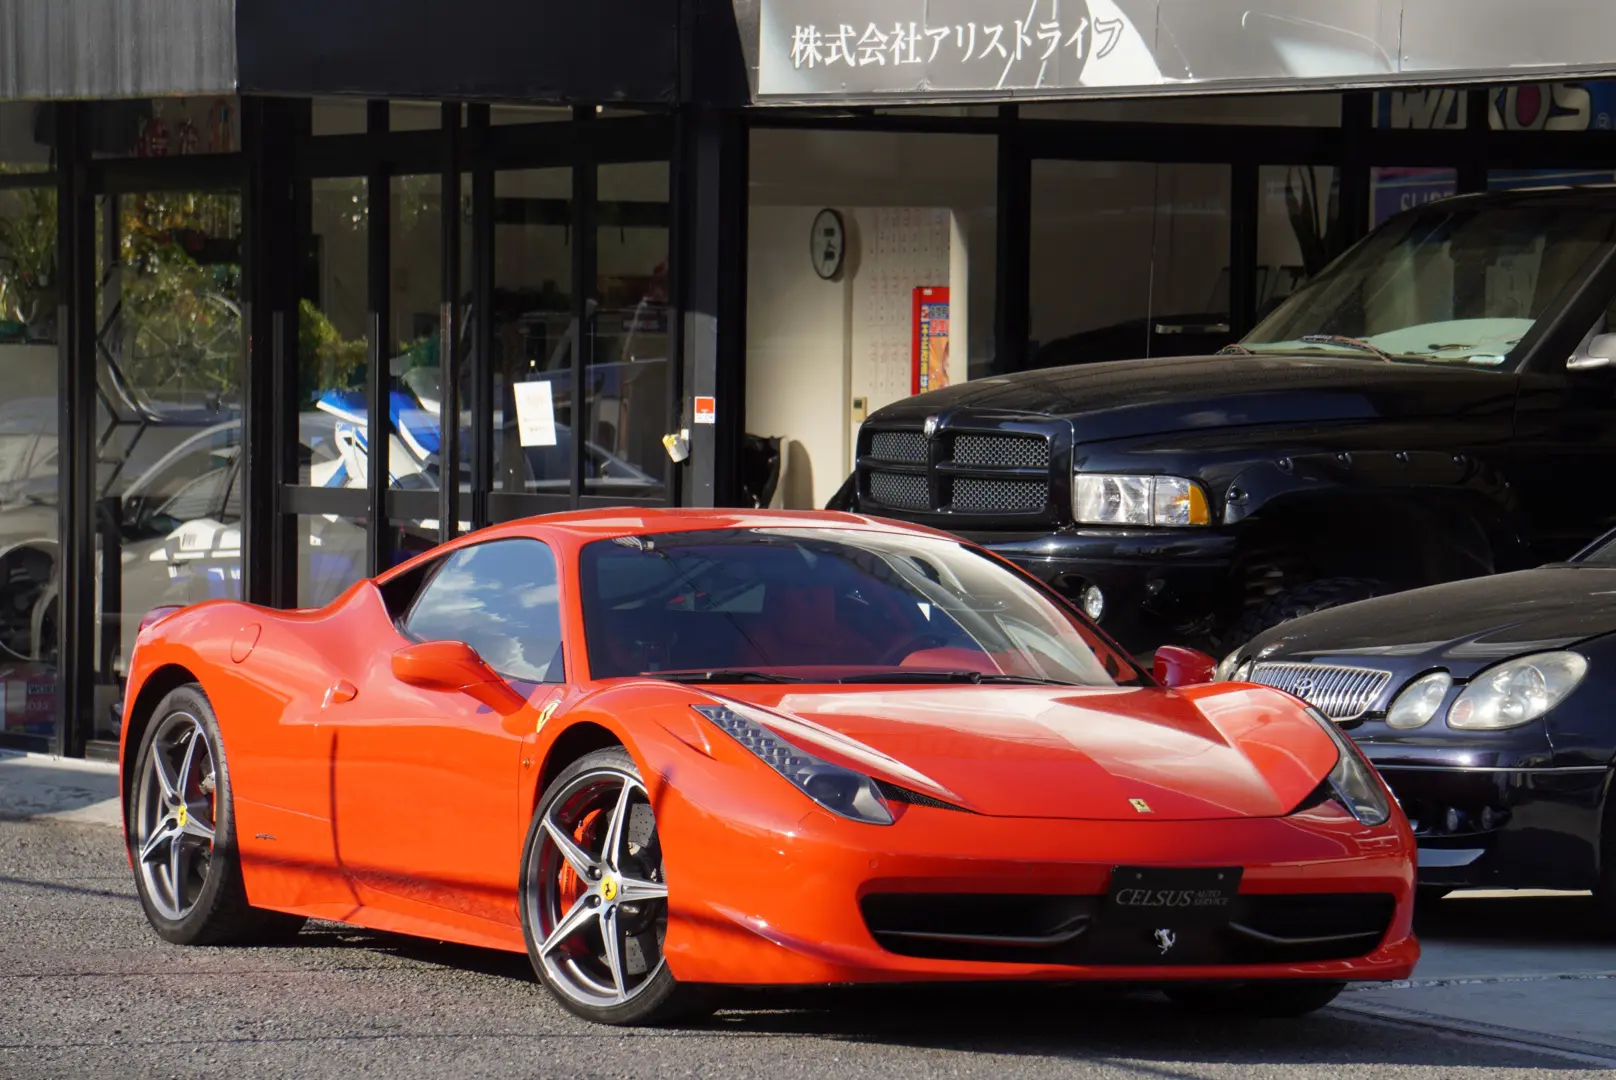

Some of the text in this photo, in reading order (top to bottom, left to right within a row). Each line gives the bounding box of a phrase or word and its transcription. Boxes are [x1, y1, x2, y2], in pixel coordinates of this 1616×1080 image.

[790, 17, 1125, 69] 株式会社アリストライフ
[1115, 888, 1195, 907] CELSUS
[1194, 889, 1222, 898] AUTO
[1193, 897, 1230, 906] SERVICE
